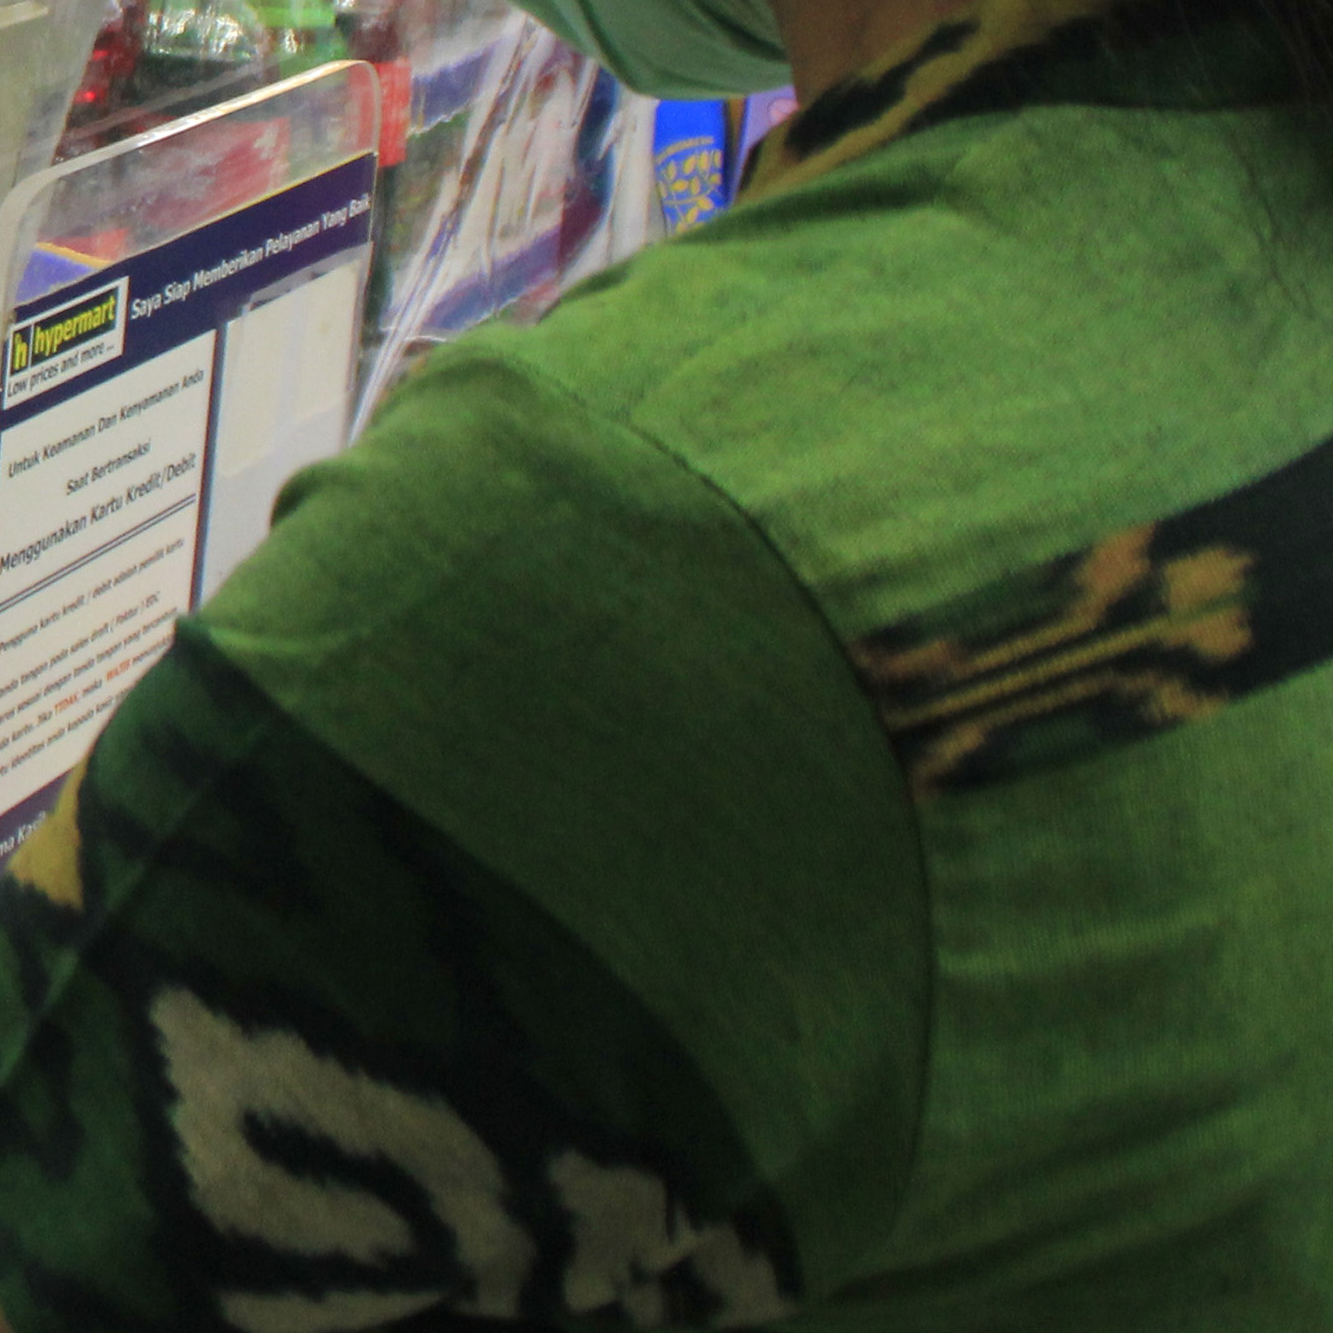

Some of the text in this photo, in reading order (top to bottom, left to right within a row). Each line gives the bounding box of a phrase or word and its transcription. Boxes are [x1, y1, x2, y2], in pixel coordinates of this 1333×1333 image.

[131, 192, 371, 321] Saya Siap Memberikan Pelayanan Yang Baik
[33, 294, 116, 356] hypermart
[7, 341, 104, 399] Low prices and more
[8, 366, 204, 479] Untuk Keamanan Dan Kenyamanan Anda
[66, 437, 151, 495] Saat Bertransaksi
[90, 489, 123, 525] Kartu
[125, 449, 197, 506] Kredit/Debit
